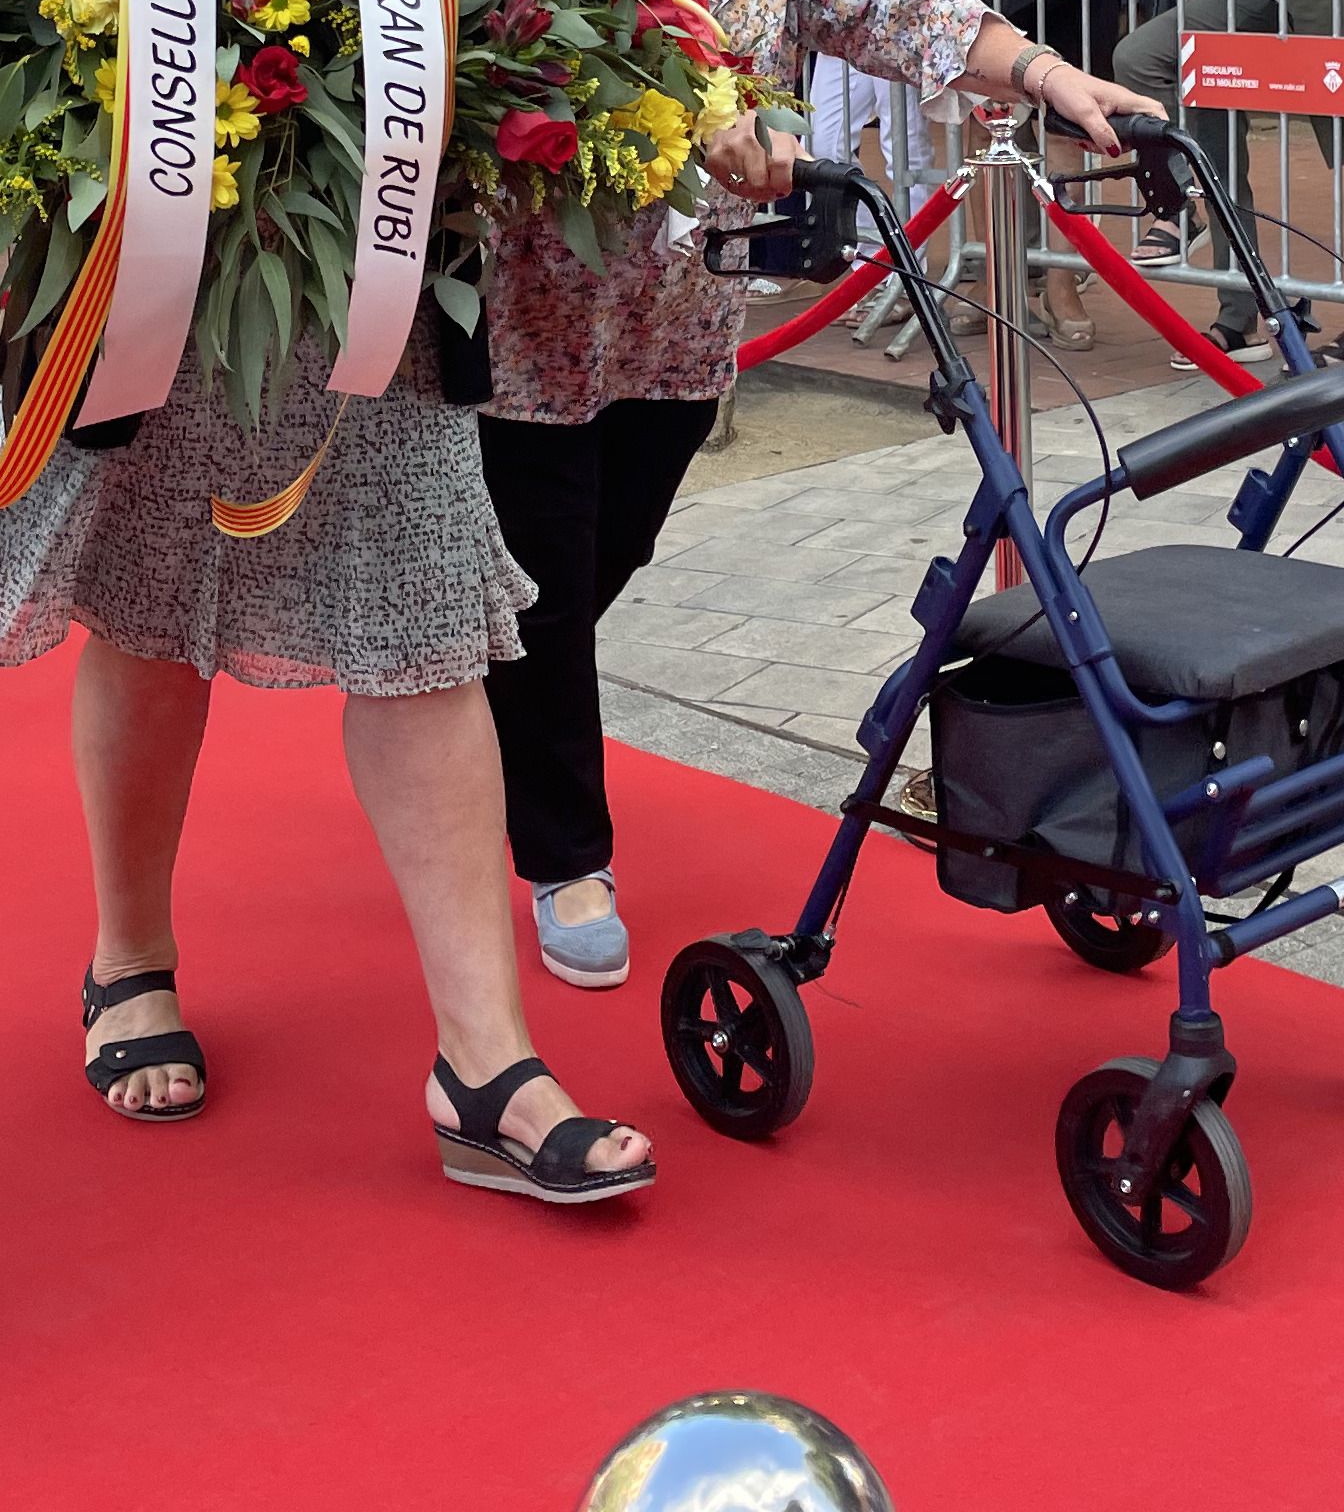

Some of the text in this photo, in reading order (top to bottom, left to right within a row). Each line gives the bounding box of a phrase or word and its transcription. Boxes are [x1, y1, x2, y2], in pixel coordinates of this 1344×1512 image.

[1201, 65, 1243, 76] DISCULPEU
[1202, 77, 1216, 87] LES
[383, 81, 427, 144] DE
